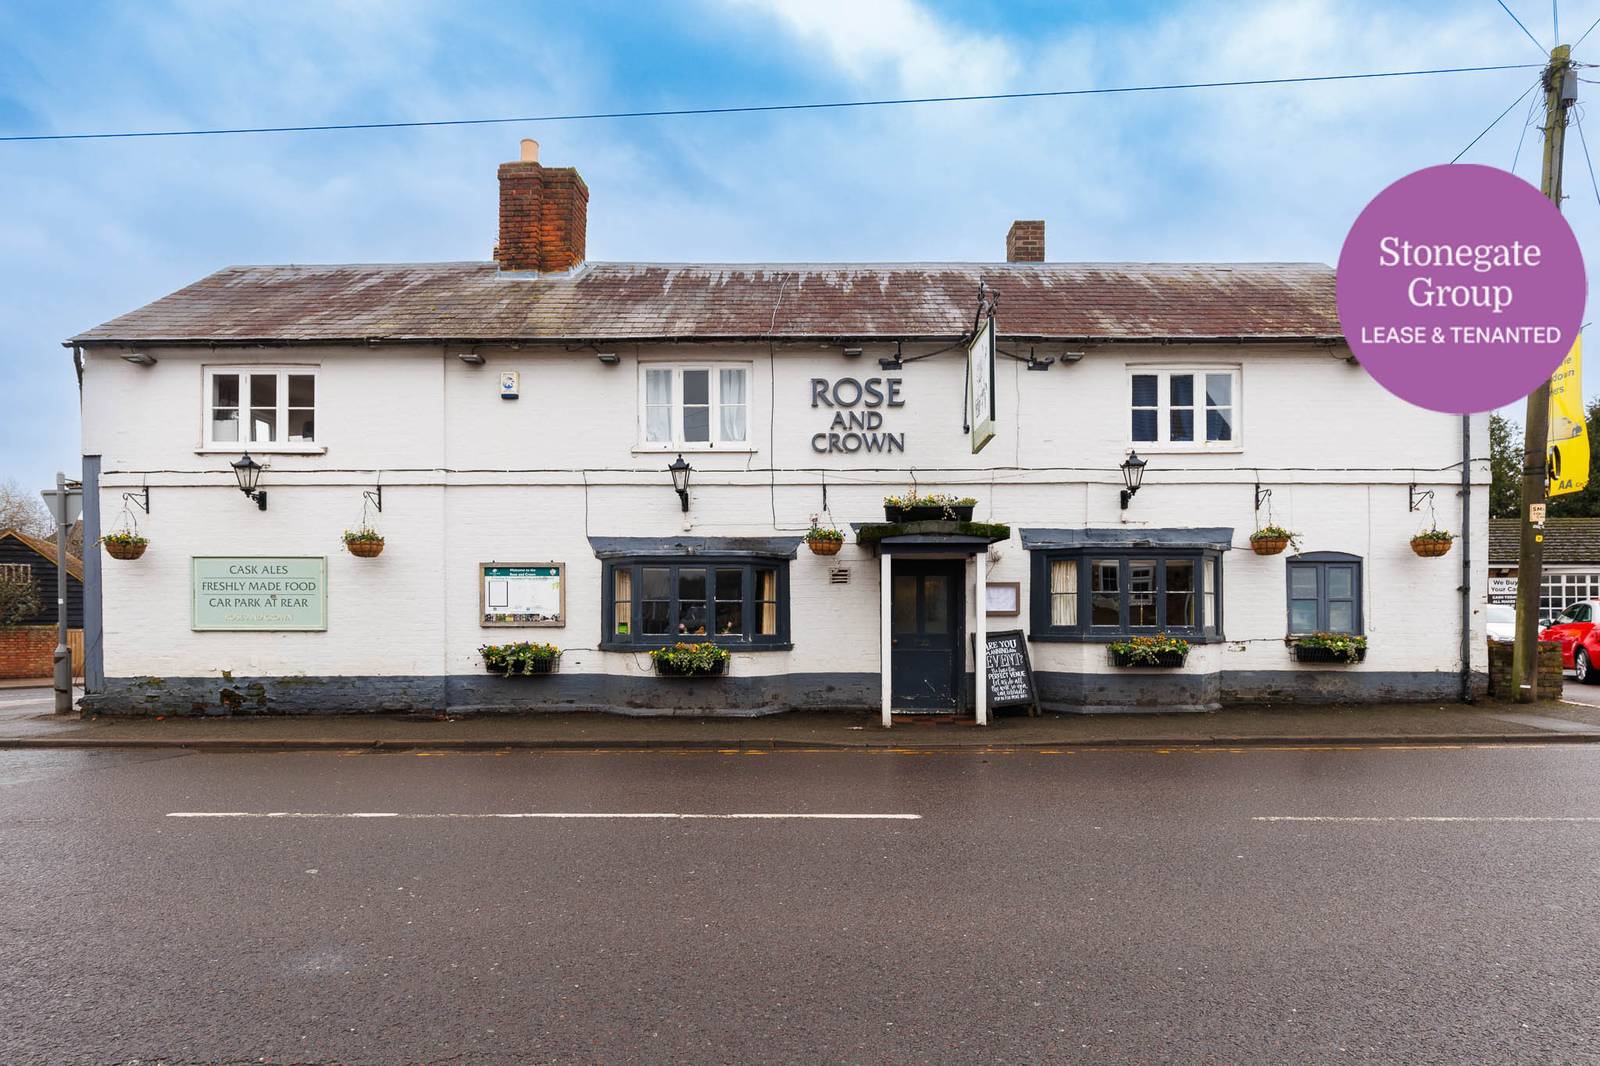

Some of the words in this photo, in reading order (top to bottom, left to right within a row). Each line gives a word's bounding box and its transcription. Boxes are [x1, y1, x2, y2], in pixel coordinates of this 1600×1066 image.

[810, 377, 906, 408] ROSE
[830, 410, 883, 430] AND
[811, 432, 905, 453] CROWN
[1558, 479, 1573, 489] AA
[229, 565, 258, 575] CASK
[261, 565, 289, 575] ALES
[202, 581, 246, 591] FRESHLY
[248, 581, 281, 591] MADE
[285, 581, 317, 591] FOOD
[1506, 579, 1518, 587] Buy
[209, 598, 232, 608] CAR
[234, 598, 261, 608] PARK
[264, 598, 277, 608] AT
[280, 598, 309, 608] REAR
[999, 639, 1017, 649] YOU
[986, 653, 1024, 668] EVENT?
